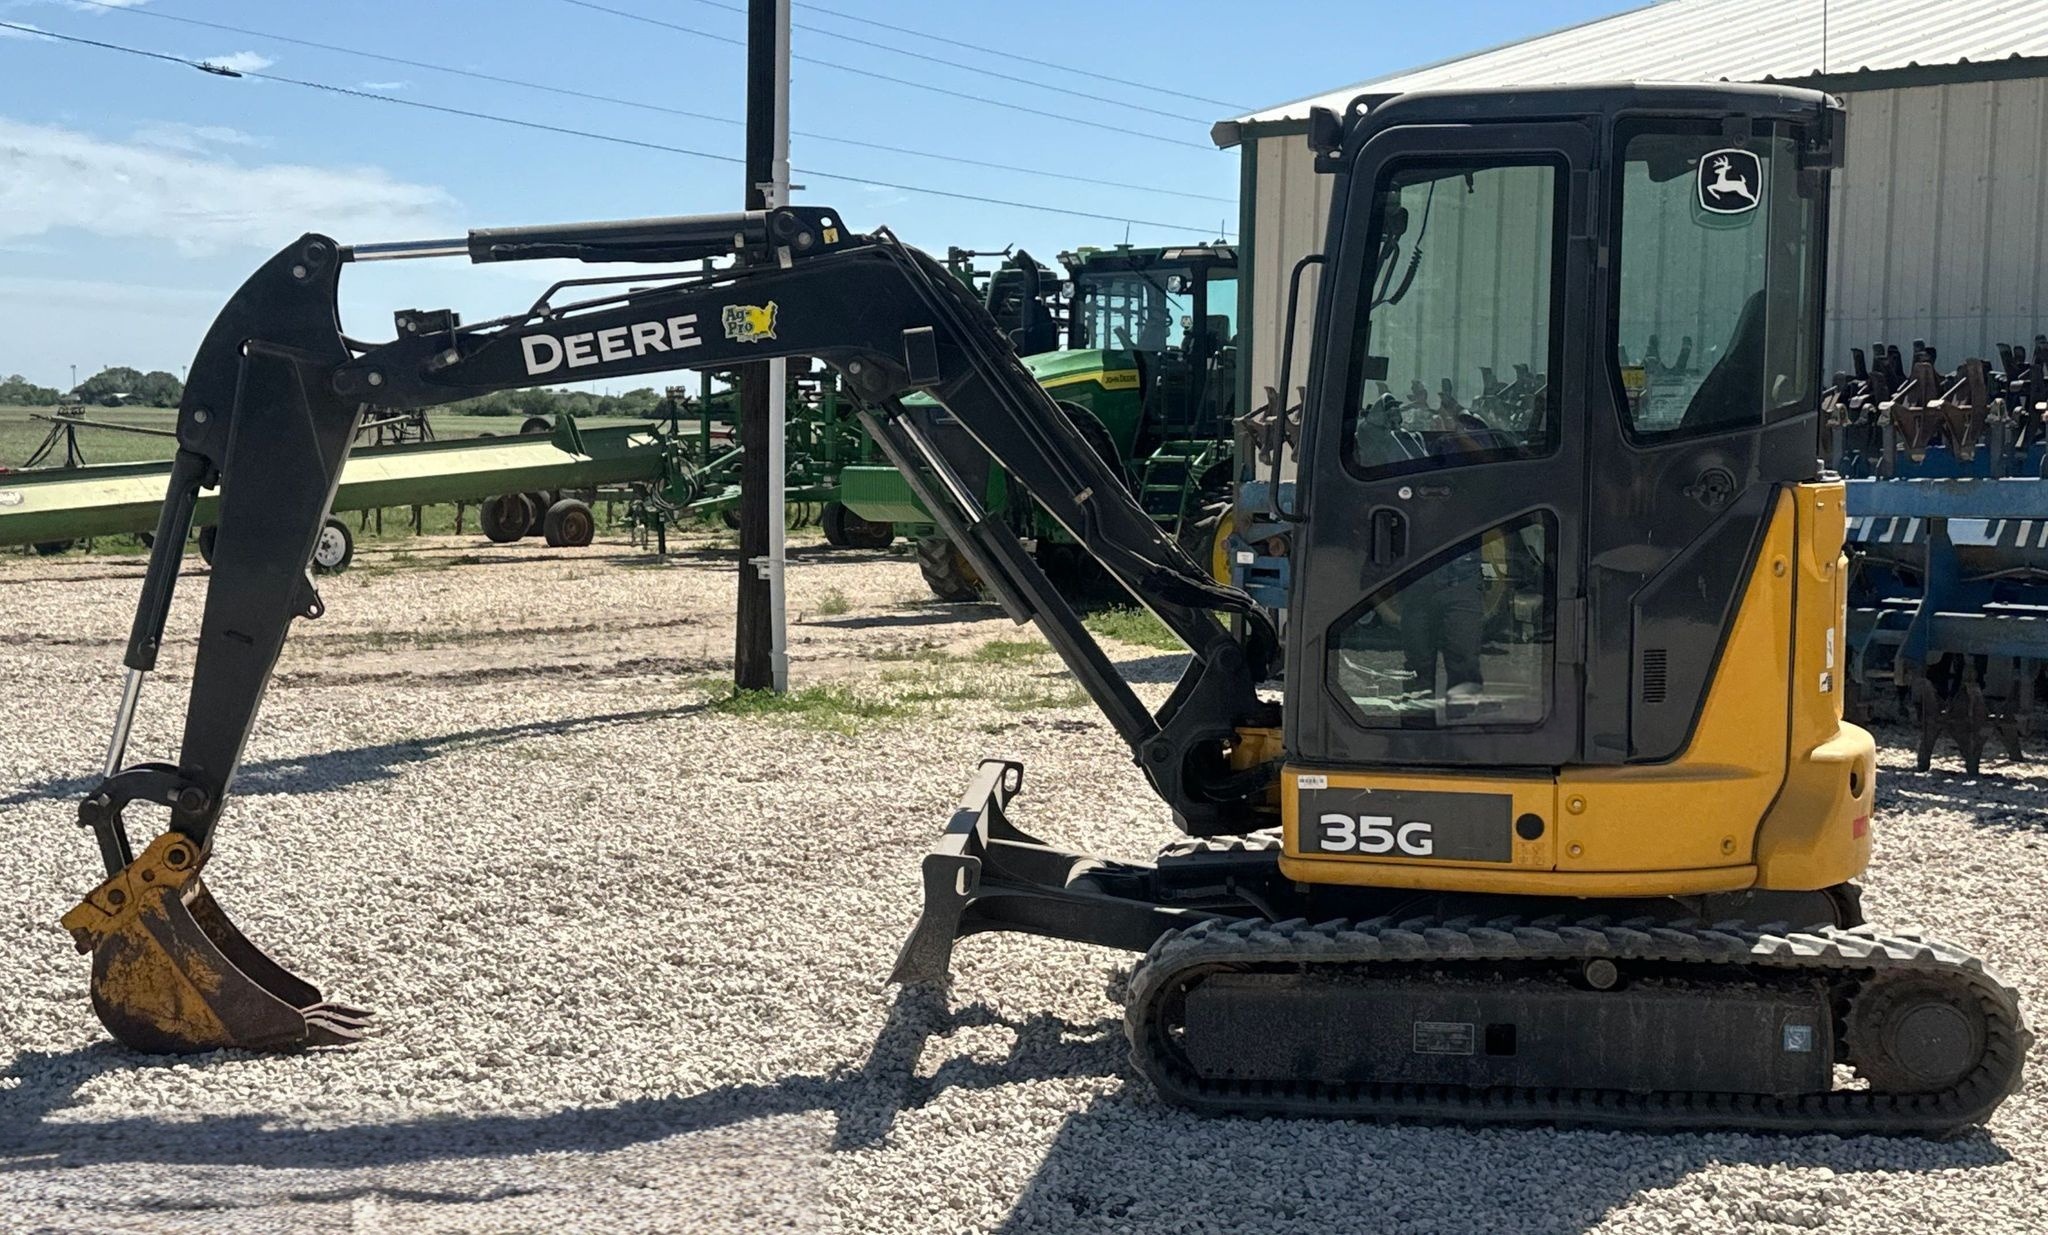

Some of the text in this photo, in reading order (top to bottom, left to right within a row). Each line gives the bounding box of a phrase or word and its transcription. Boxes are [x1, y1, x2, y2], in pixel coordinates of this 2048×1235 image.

[726, 308, 752, 323] Ag-
[727, 322, 753, 335] Pro
[521, 314, 702, 376] DEERE
[1320, 813, 1433, 855] 35G
